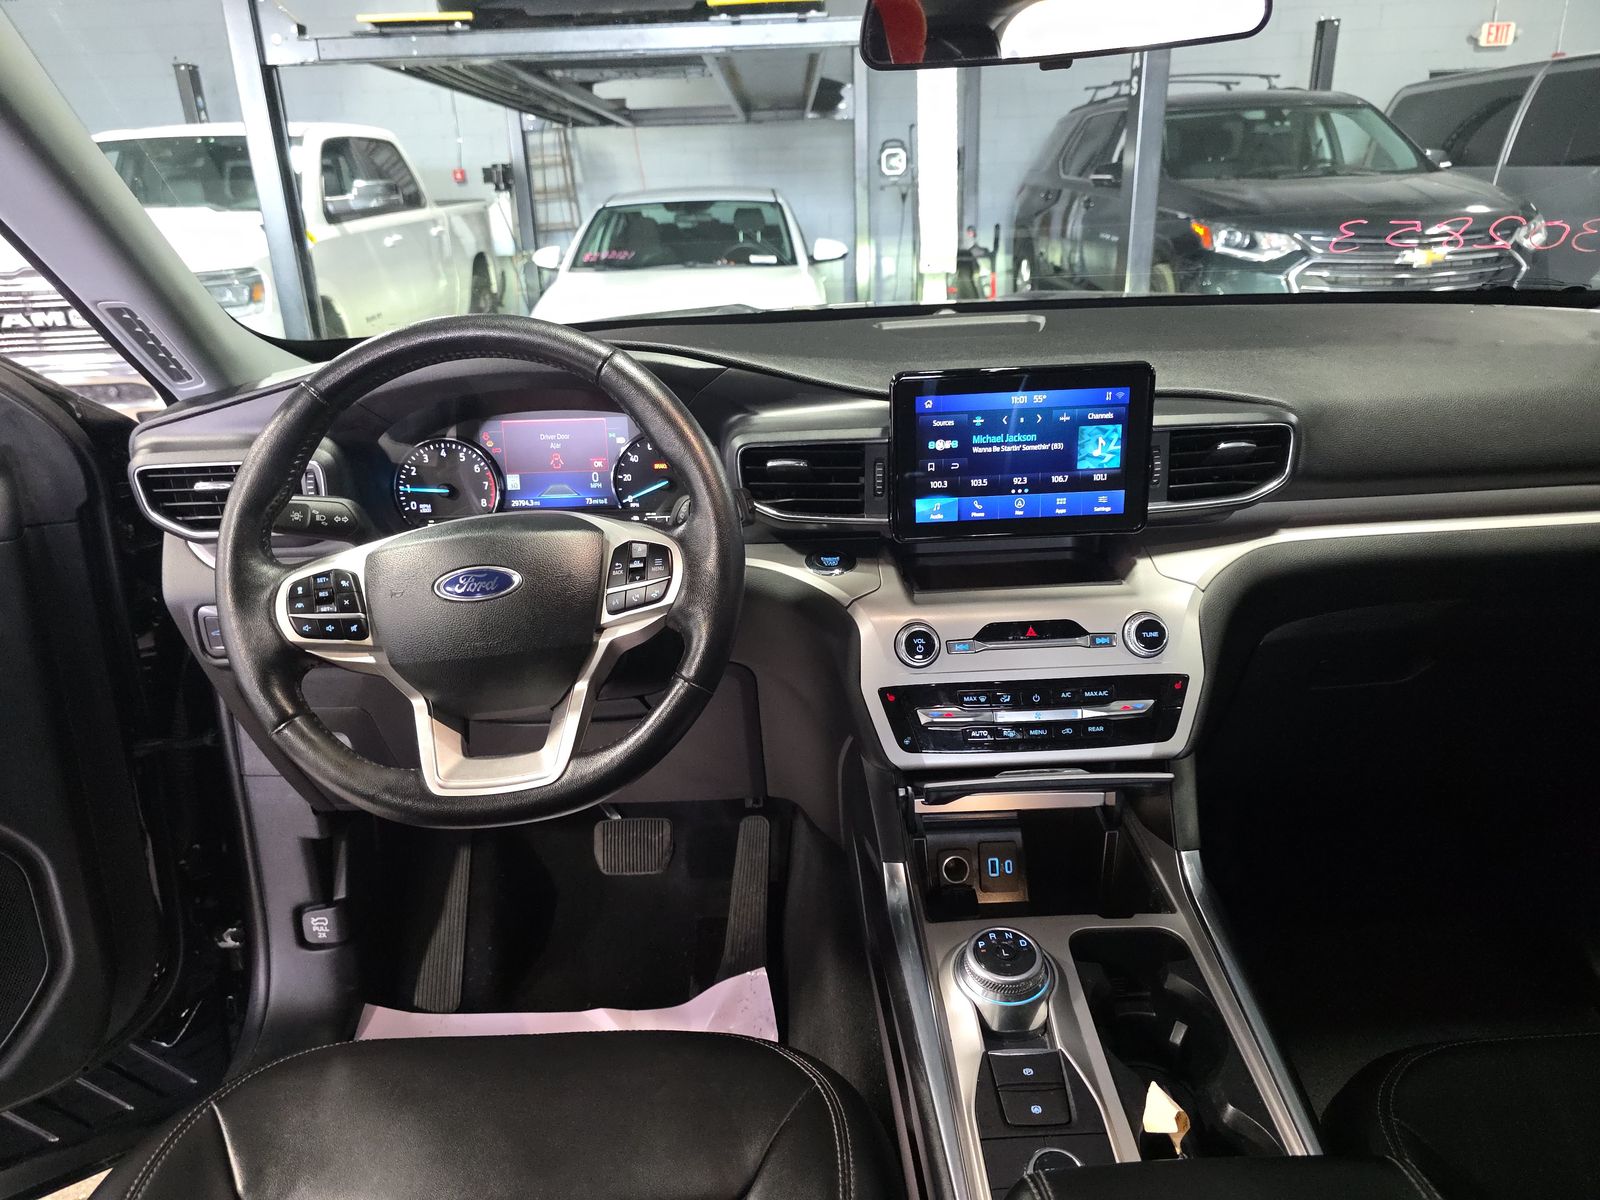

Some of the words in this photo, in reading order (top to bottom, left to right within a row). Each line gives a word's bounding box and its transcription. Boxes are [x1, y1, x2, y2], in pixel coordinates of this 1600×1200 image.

[1486, 23, 1512, 44] EXIT
[1011, 396, 1028, 404] 11:01
[1033, 394, 1047, 404] 55°
[1087, 411, 1115, 420] Channels
[932, 419, 955, 427] Sources
[539, 433, 556, 441] Driver
[972, 434, 1004, 444] Michael
[1004, 432, 1037, 443] Jackson
[440, 448, 447, 457] 4
[459, 452, 466, 462] 5
[422, 454, 429, 463] 3
[629, 455, 639, 463] 40
[410, 466, 417, 476] 2
[473, 464, 481, 473] 6
[623, 474, 632, 482] 20
[1051, 475, 1069, 483] 106.7
[1093, 473, 1107, 481] 101.1
[482, 481, 489, 490] 7
[930, 480, 948, 488] 100.3
[970, 479, 988, 487] 103.5
[410, 501, 417, 510] 0
[480, 498, 487, 507] 8
[454, 573, 500, 594] Ford
[978, 941, 985, 949] P
